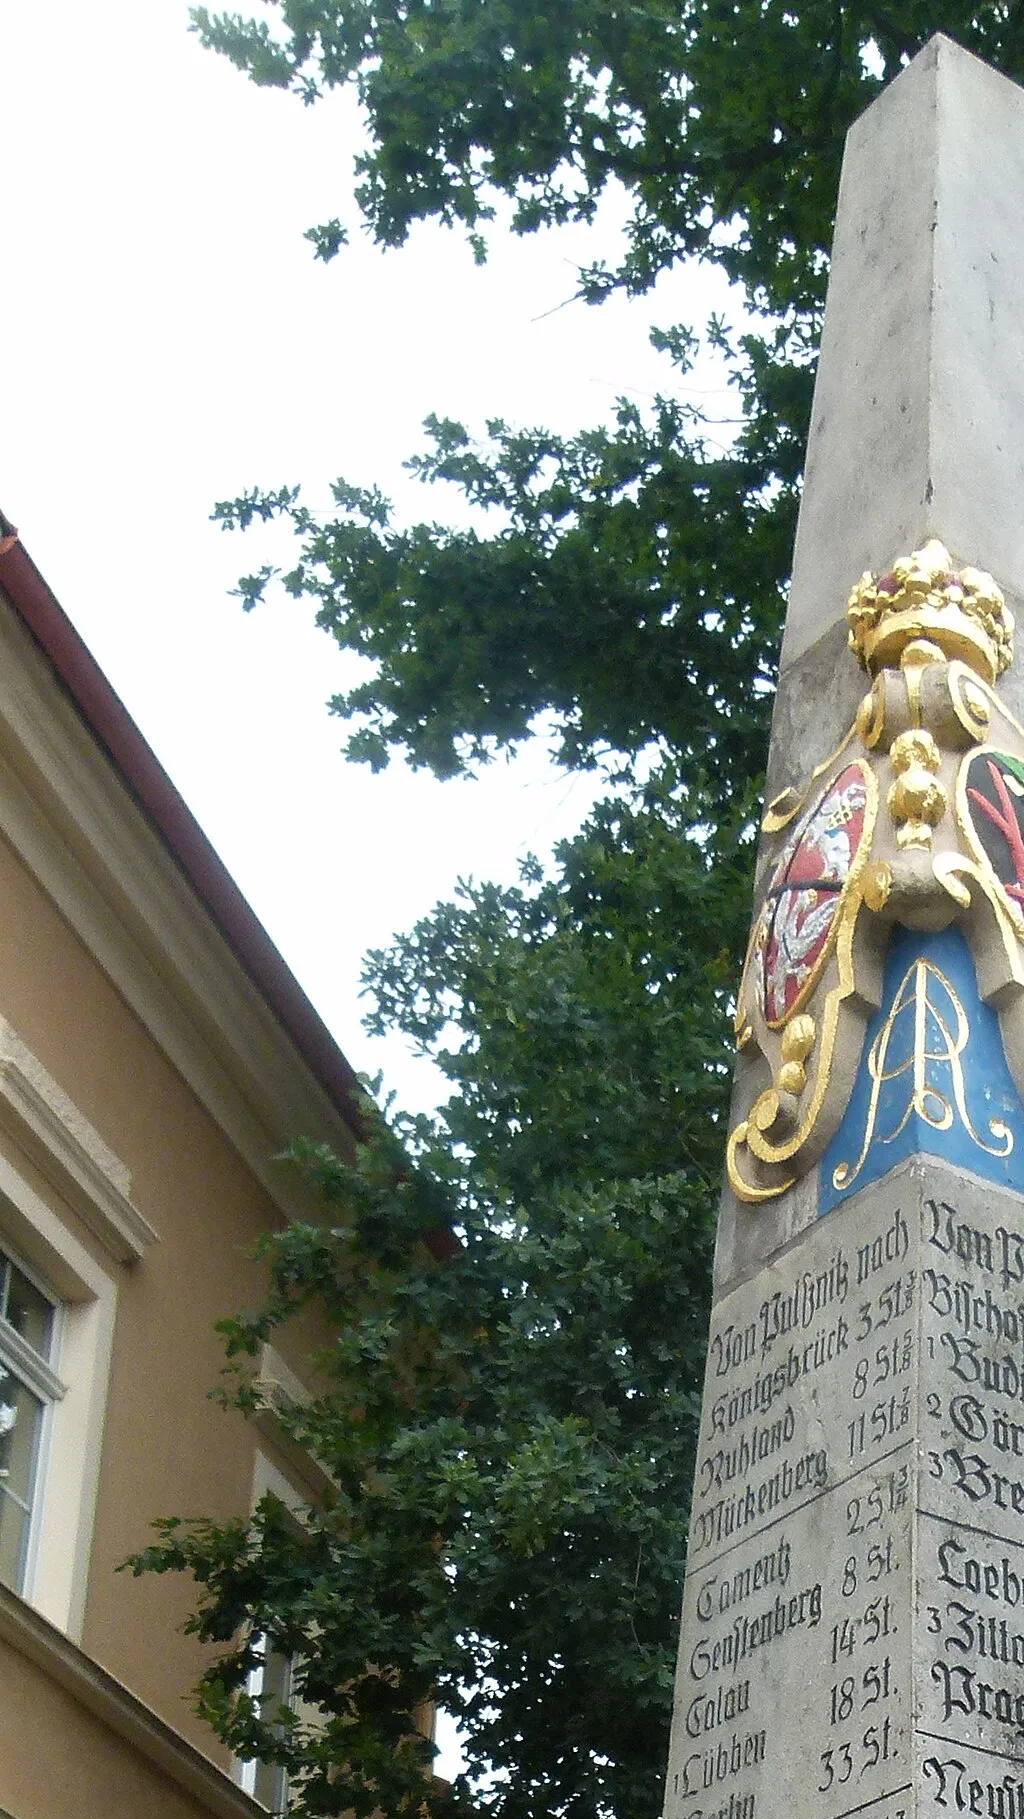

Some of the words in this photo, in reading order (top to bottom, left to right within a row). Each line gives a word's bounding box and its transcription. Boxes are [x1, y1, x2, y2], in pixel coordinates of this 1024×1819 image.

[924, 1199, 993, 1274] Von
[711, 1323, 756, 1377] Von
[857, 1208, 908, 1285] nach
[856, 1302, 873, 1341] 3
[852, 1358, 869, 1399] 8
[927, 1394, 942, 1420] 2
[848, 1412, 866, 1457] 11
[928, 1451, 943, 1479] 3
[847, 1499, 864, 1536] 2
[841, 1556, 857, 1597] 8
[831, 1620, 855, 1663] 14
[863, 1595, 898, 1645] St.
[927, 1606, 942, 1634] 3
[831, 1677, 854, 1725] 18
[862, 1656, 898, 1711] St.
[819, 1743, 853, 1791] 33
[862, 1717, 898, 1776] St.
